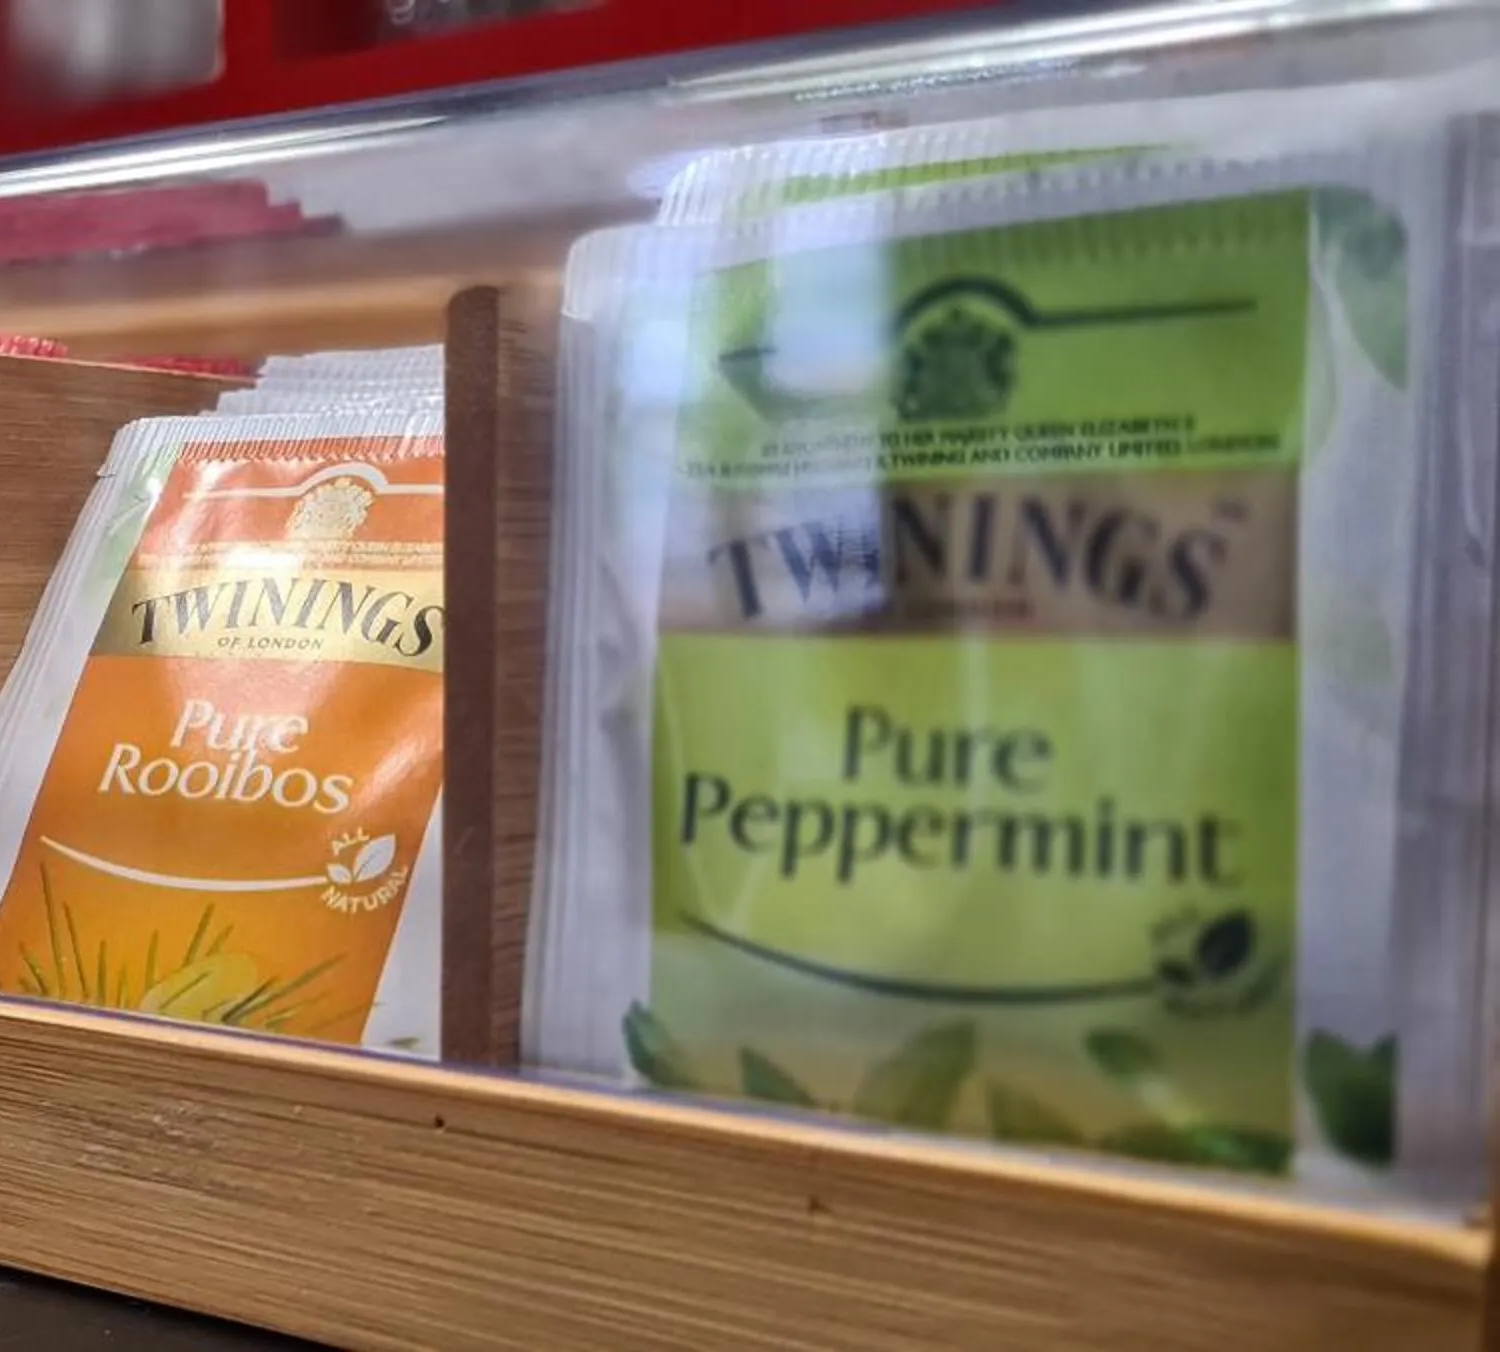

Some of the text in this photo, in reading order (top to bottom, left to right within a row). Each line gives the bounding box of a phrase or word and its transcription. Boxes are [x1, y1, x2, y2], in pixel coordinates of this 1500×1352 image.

[132, 577, 445, 657] TWININGS
[217, 636, 325, 650] OF LONDON
[170, 699, 308, 754] Pure
[842, 702, 1054, 794] Pure
[98, 743, 353, 814] Rooibos
[332, 826, 370, 857] ALL
[679, 771, 1245, 888] Peppermint
[321, 865, 409, 915] NATURAL
